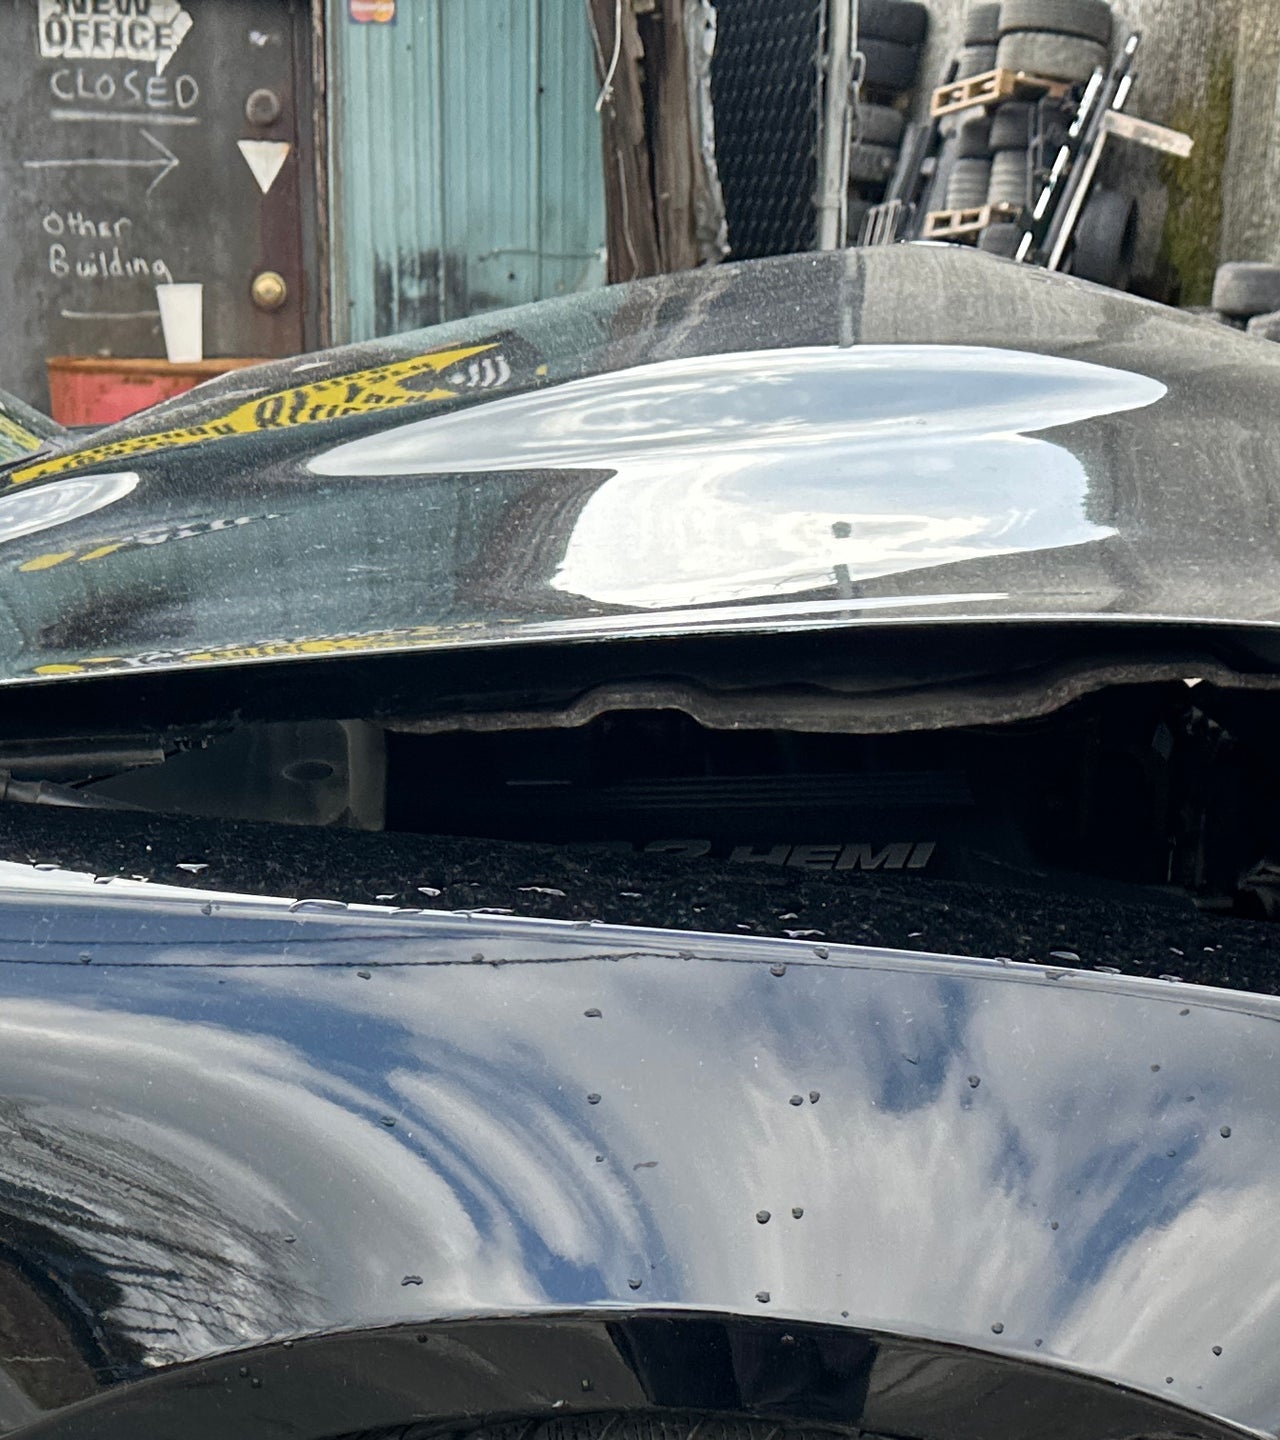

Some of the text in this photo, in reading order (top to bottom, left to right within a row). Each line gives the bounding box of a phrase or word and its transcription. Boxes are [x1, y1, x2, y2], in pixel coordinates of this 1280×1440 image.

[45, 19, 172, 50] OFFICE
[50, 69, 199, 109] CLOSED
[42, 210, 132, 238] Other
[49, 243, 174, 284] Building
